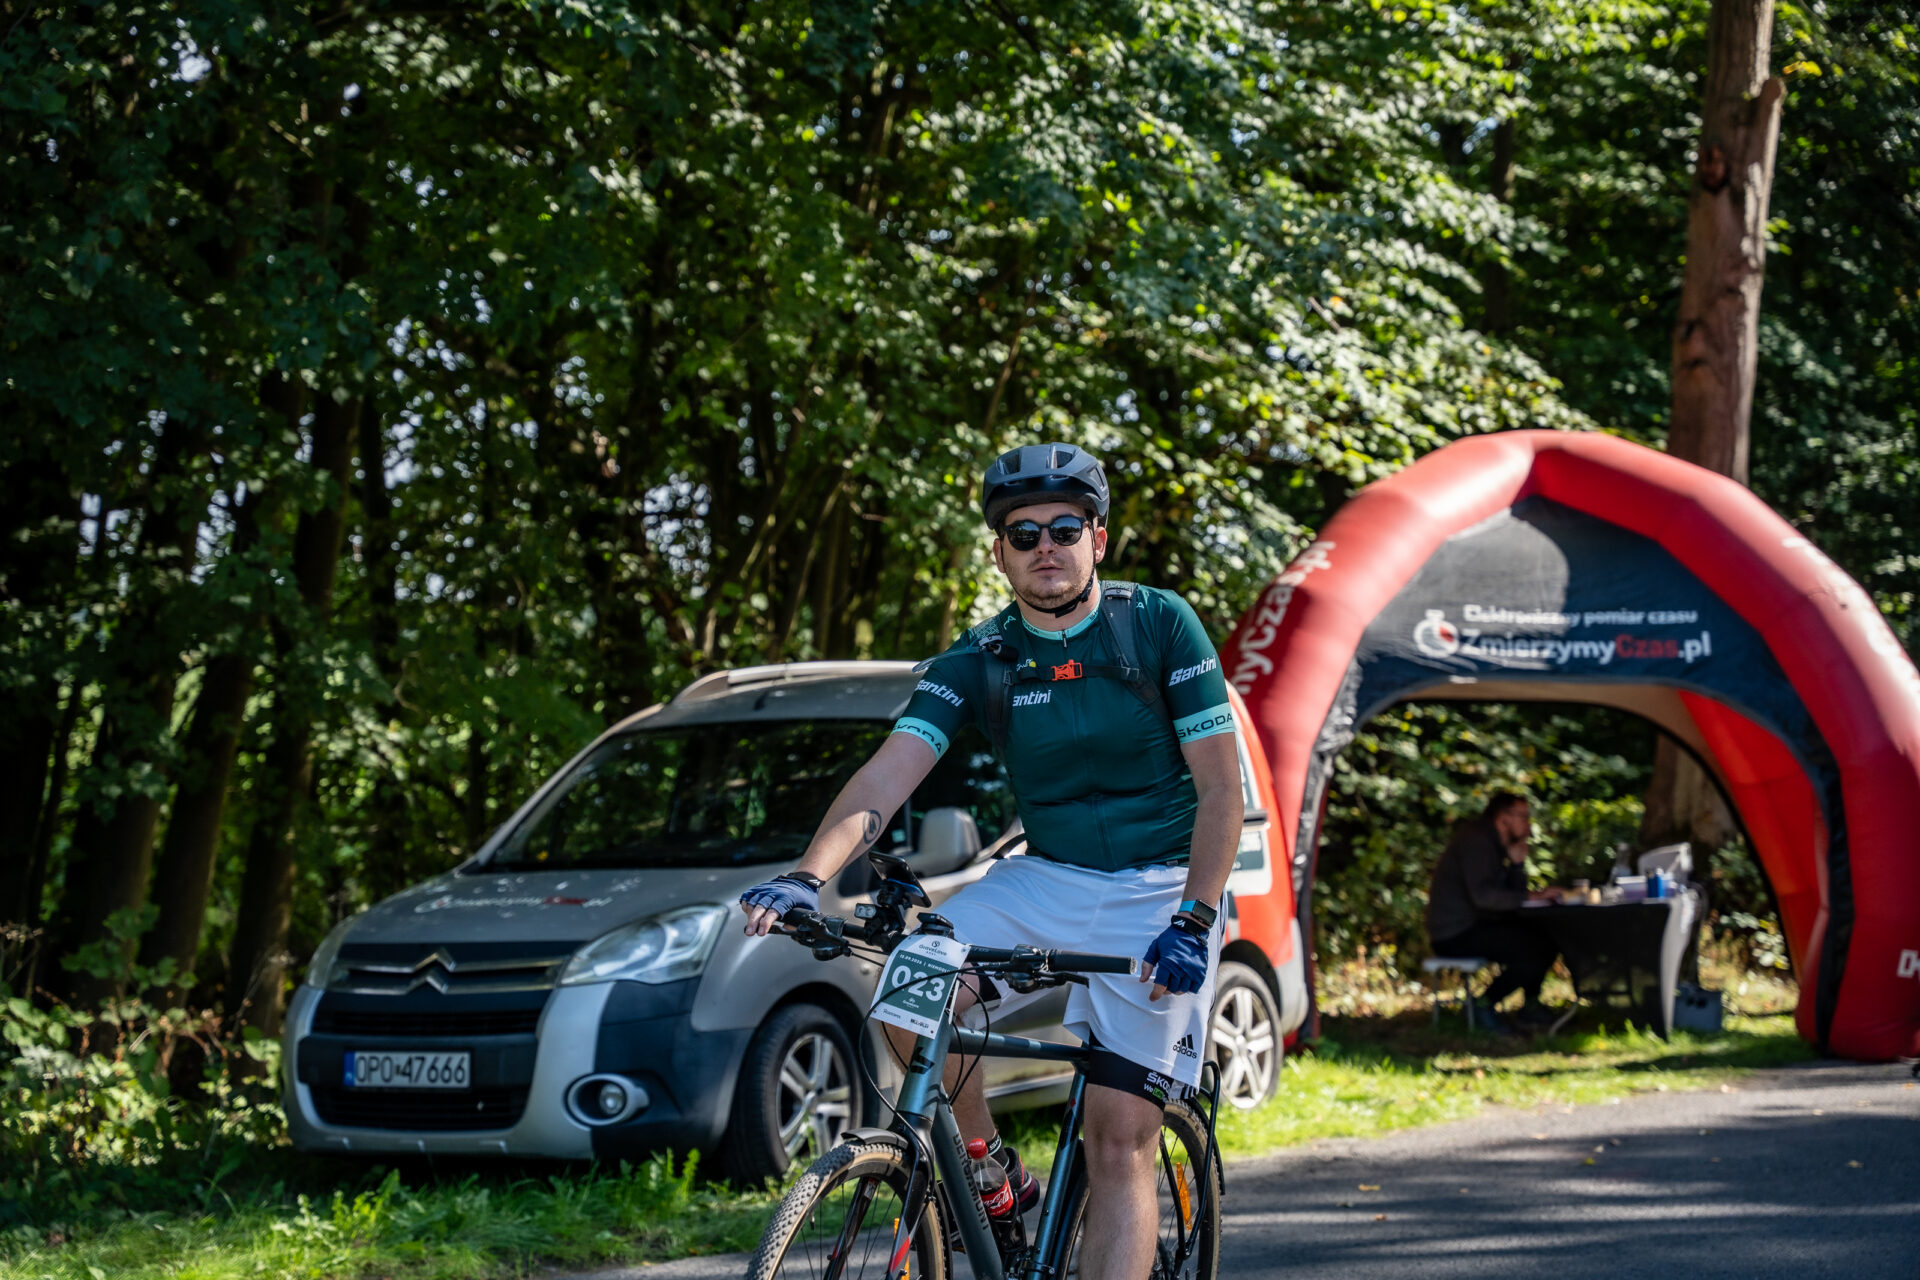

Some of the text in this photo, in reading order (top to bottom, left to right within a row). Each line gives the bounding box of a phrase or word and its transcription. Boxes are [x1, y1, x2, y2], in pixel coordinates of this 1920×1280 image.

[1584, 607, 1645, 627] pomiar
[1647, 610, 1698, 624] czasu
[1461, 629, 1712, 665] ZmierzymyCzas.pl
[1168, 655, 1217, 687] Santini
[1012, 690, 1052, 707] antini
[891, 965, 945, 1002] 023
[1172, 1044, 1198, 1059] adidas
[400, 1055, 465, 1083] 47666
